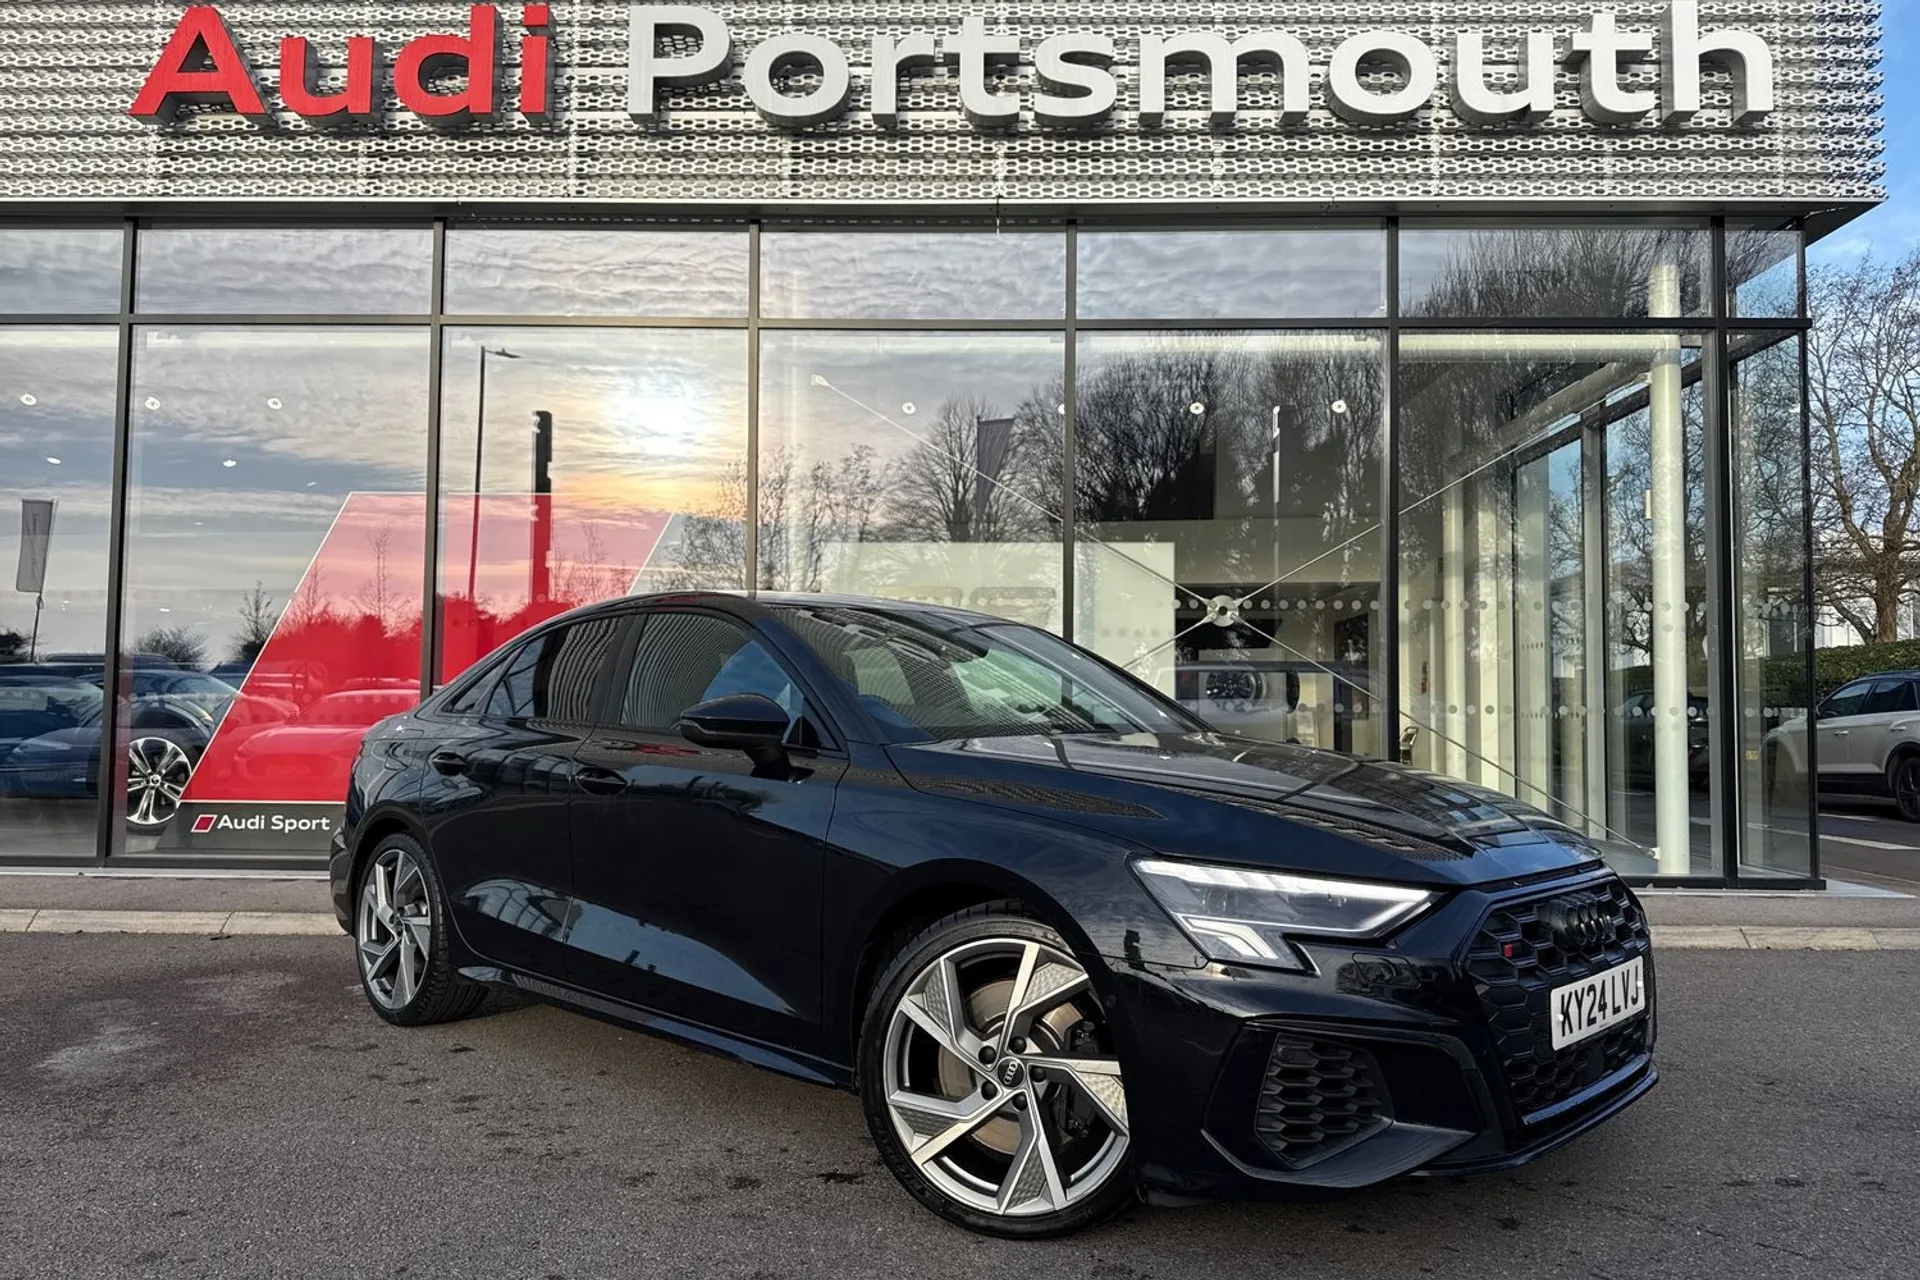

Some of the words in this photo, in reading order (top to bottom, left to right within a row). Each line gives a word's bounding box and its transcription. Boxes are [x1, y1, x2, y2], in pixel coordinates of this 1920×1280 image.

[129, 5, 554, 120] Audi
[626, 0, 1775, 124] Portsmouth
[217, 814, 265, 830] Audi
[271, 815, 331, 833] Sport
[1561, 979, 1608, 1037] KY24
[1611, 964, 1640, 1015] LVJ
